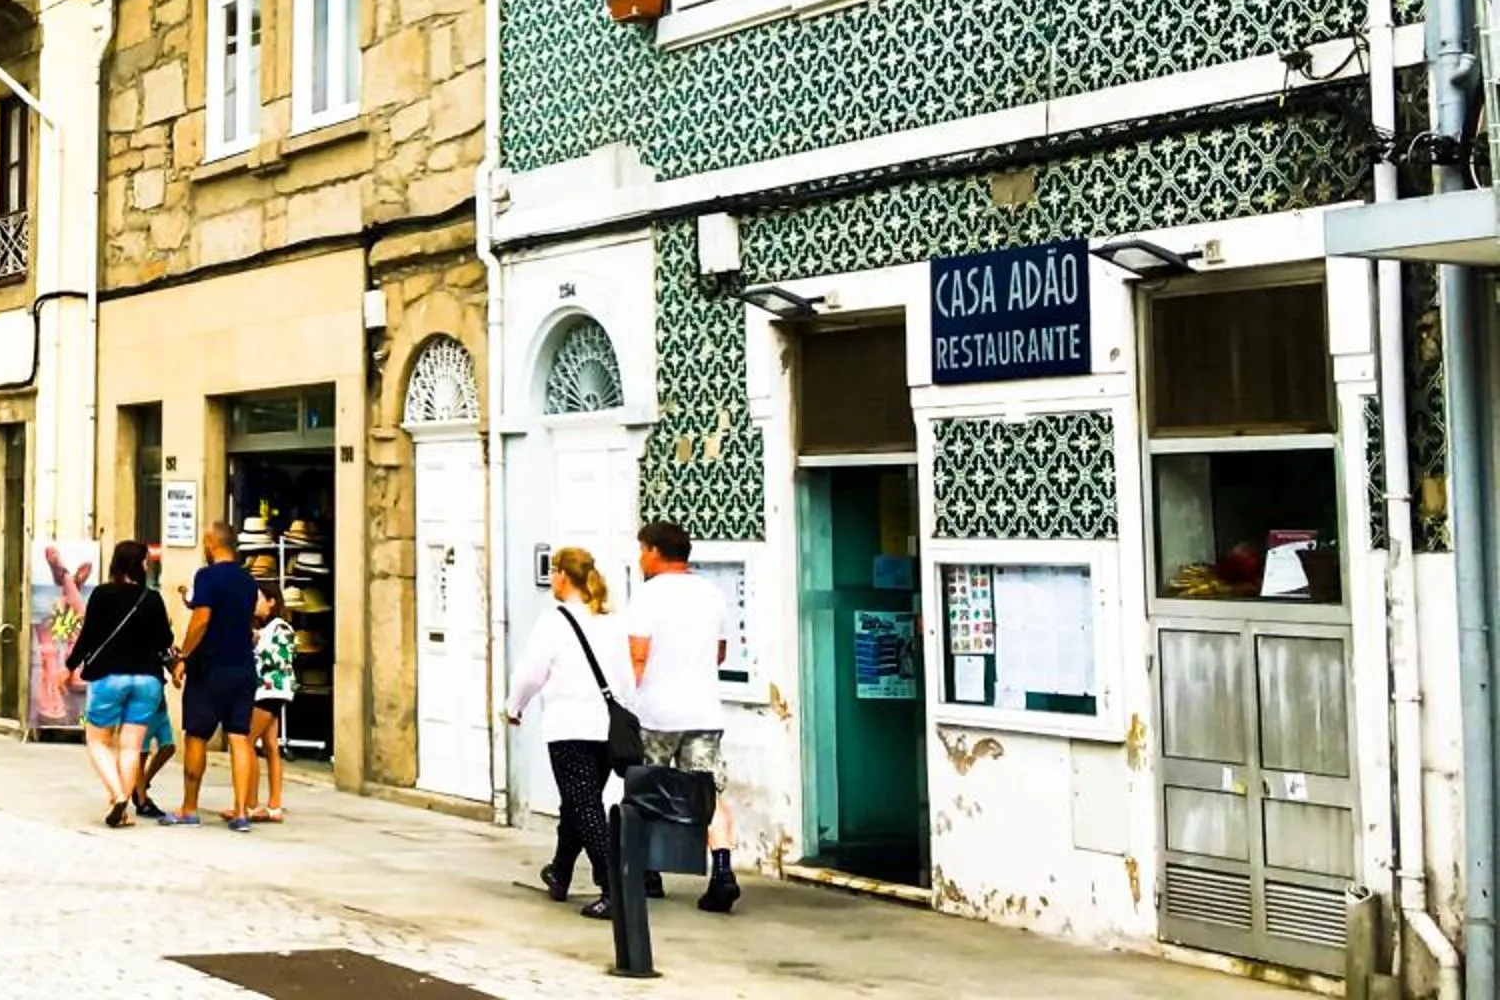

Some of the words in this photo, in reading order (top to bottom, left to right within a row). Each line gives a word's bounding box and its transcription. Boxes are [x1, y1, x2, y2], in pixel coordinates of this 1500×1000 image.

[935, 265, 997, 318] CASA
[1007, 248, 1079, 312] ADÃO
[936, 323, 1081, 370] RESTAURANTE
